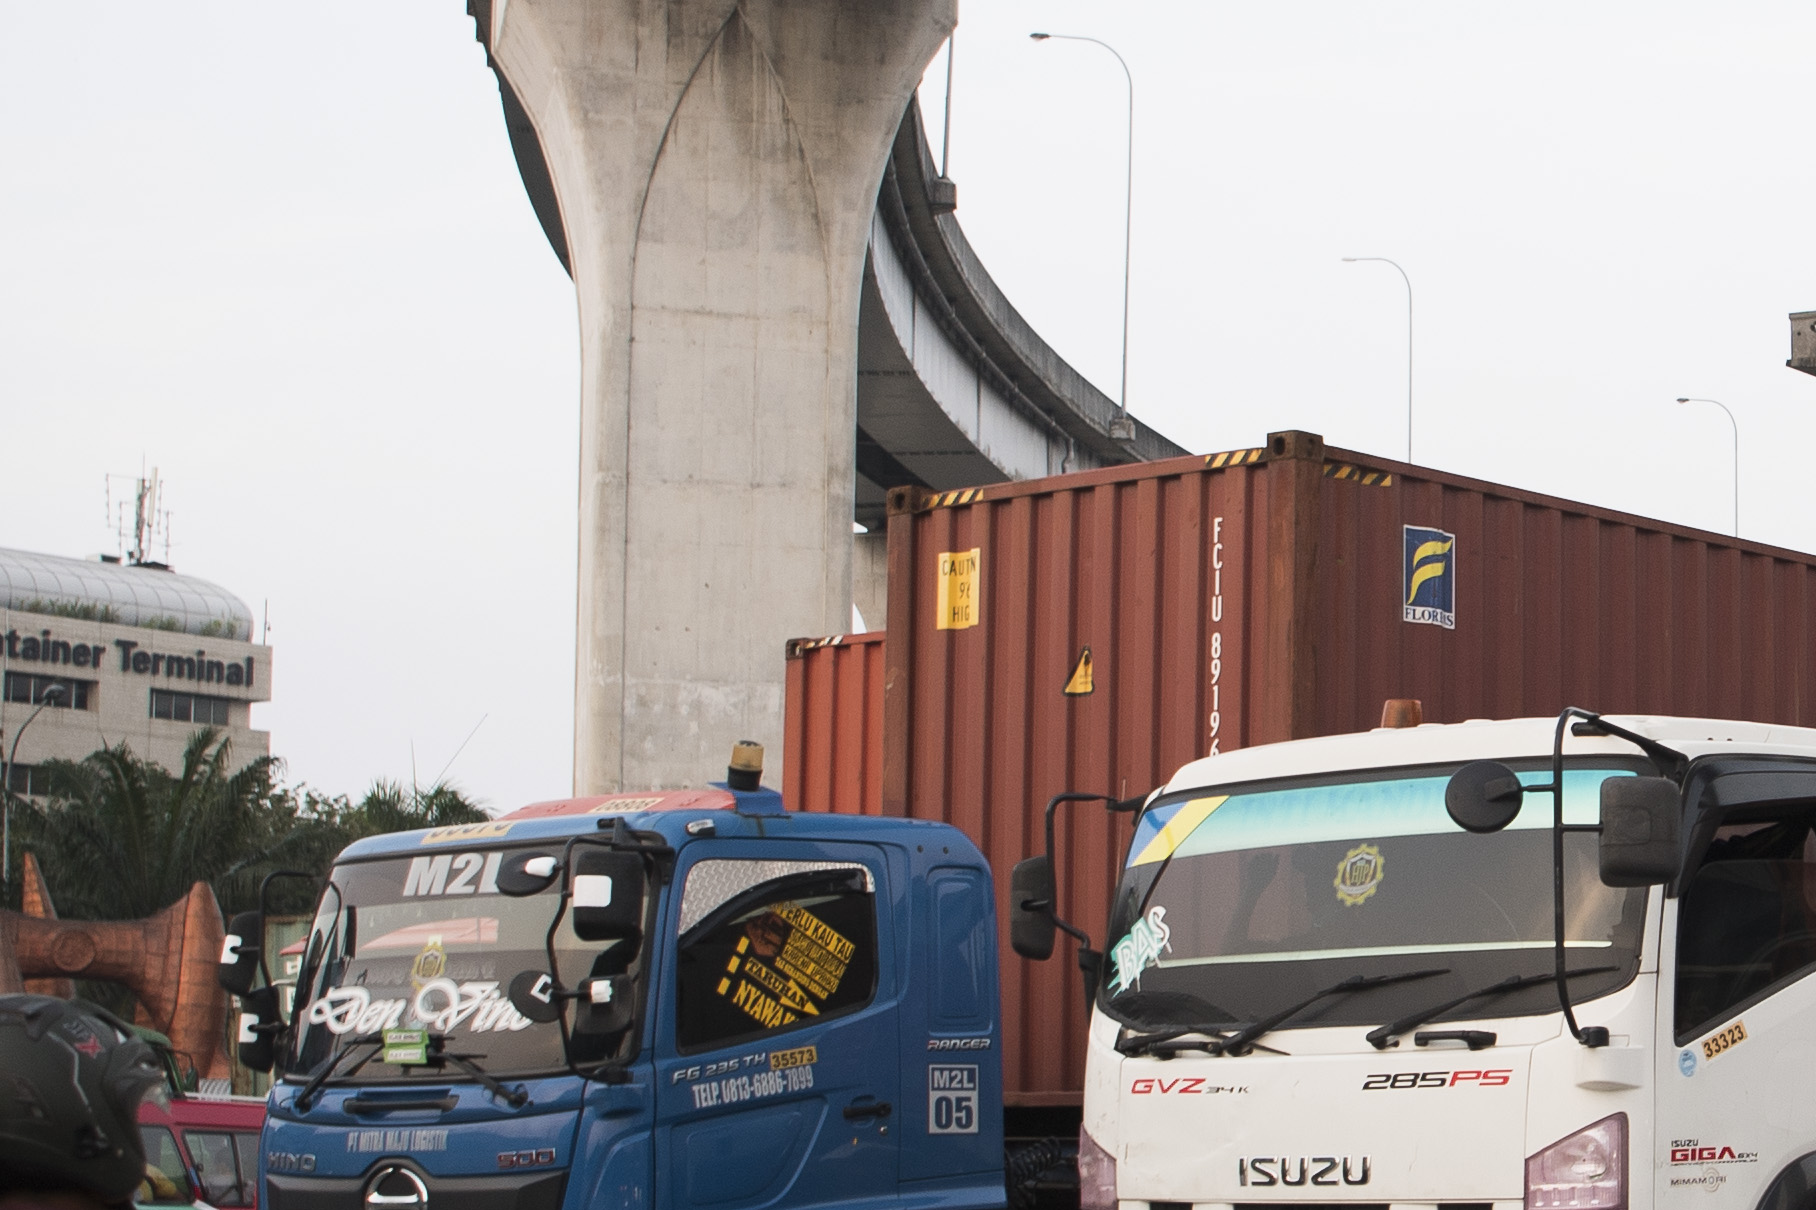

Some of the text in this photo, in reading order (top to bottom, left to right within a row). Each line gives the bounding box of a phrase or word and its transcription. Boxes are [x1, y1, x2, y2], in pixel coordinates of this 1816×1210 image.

[1211, 516, 1223, 622] FCIU
[0, 629, 254, 687] tainer Terminal
[746, 959, 807, 1009] TARUHAN
[927, 1038, 991, 1050] RANGER
[1703, 1025, 1744, 1058] 33323
[672, 1052, 766, 1084] FG 235 TH
[772, 1049, 814, 1069] 35573
[933, 1070, 974, 1089] M2L
[1131, 1078, 1207, 1094] GVZ
[1362, 1069, 1513, 1091] 285PS
[934, 1095, 974, 1130] 05
[1671, 1139, 1699, 1148] ISUZU
[1671, 1146, 1736, 1162] GIGA
[268, 1152, 316, 1172] HINO
[497, 1148, 556, 1168] 500
[1238, 1153, 1373, 1188] ISUZU
